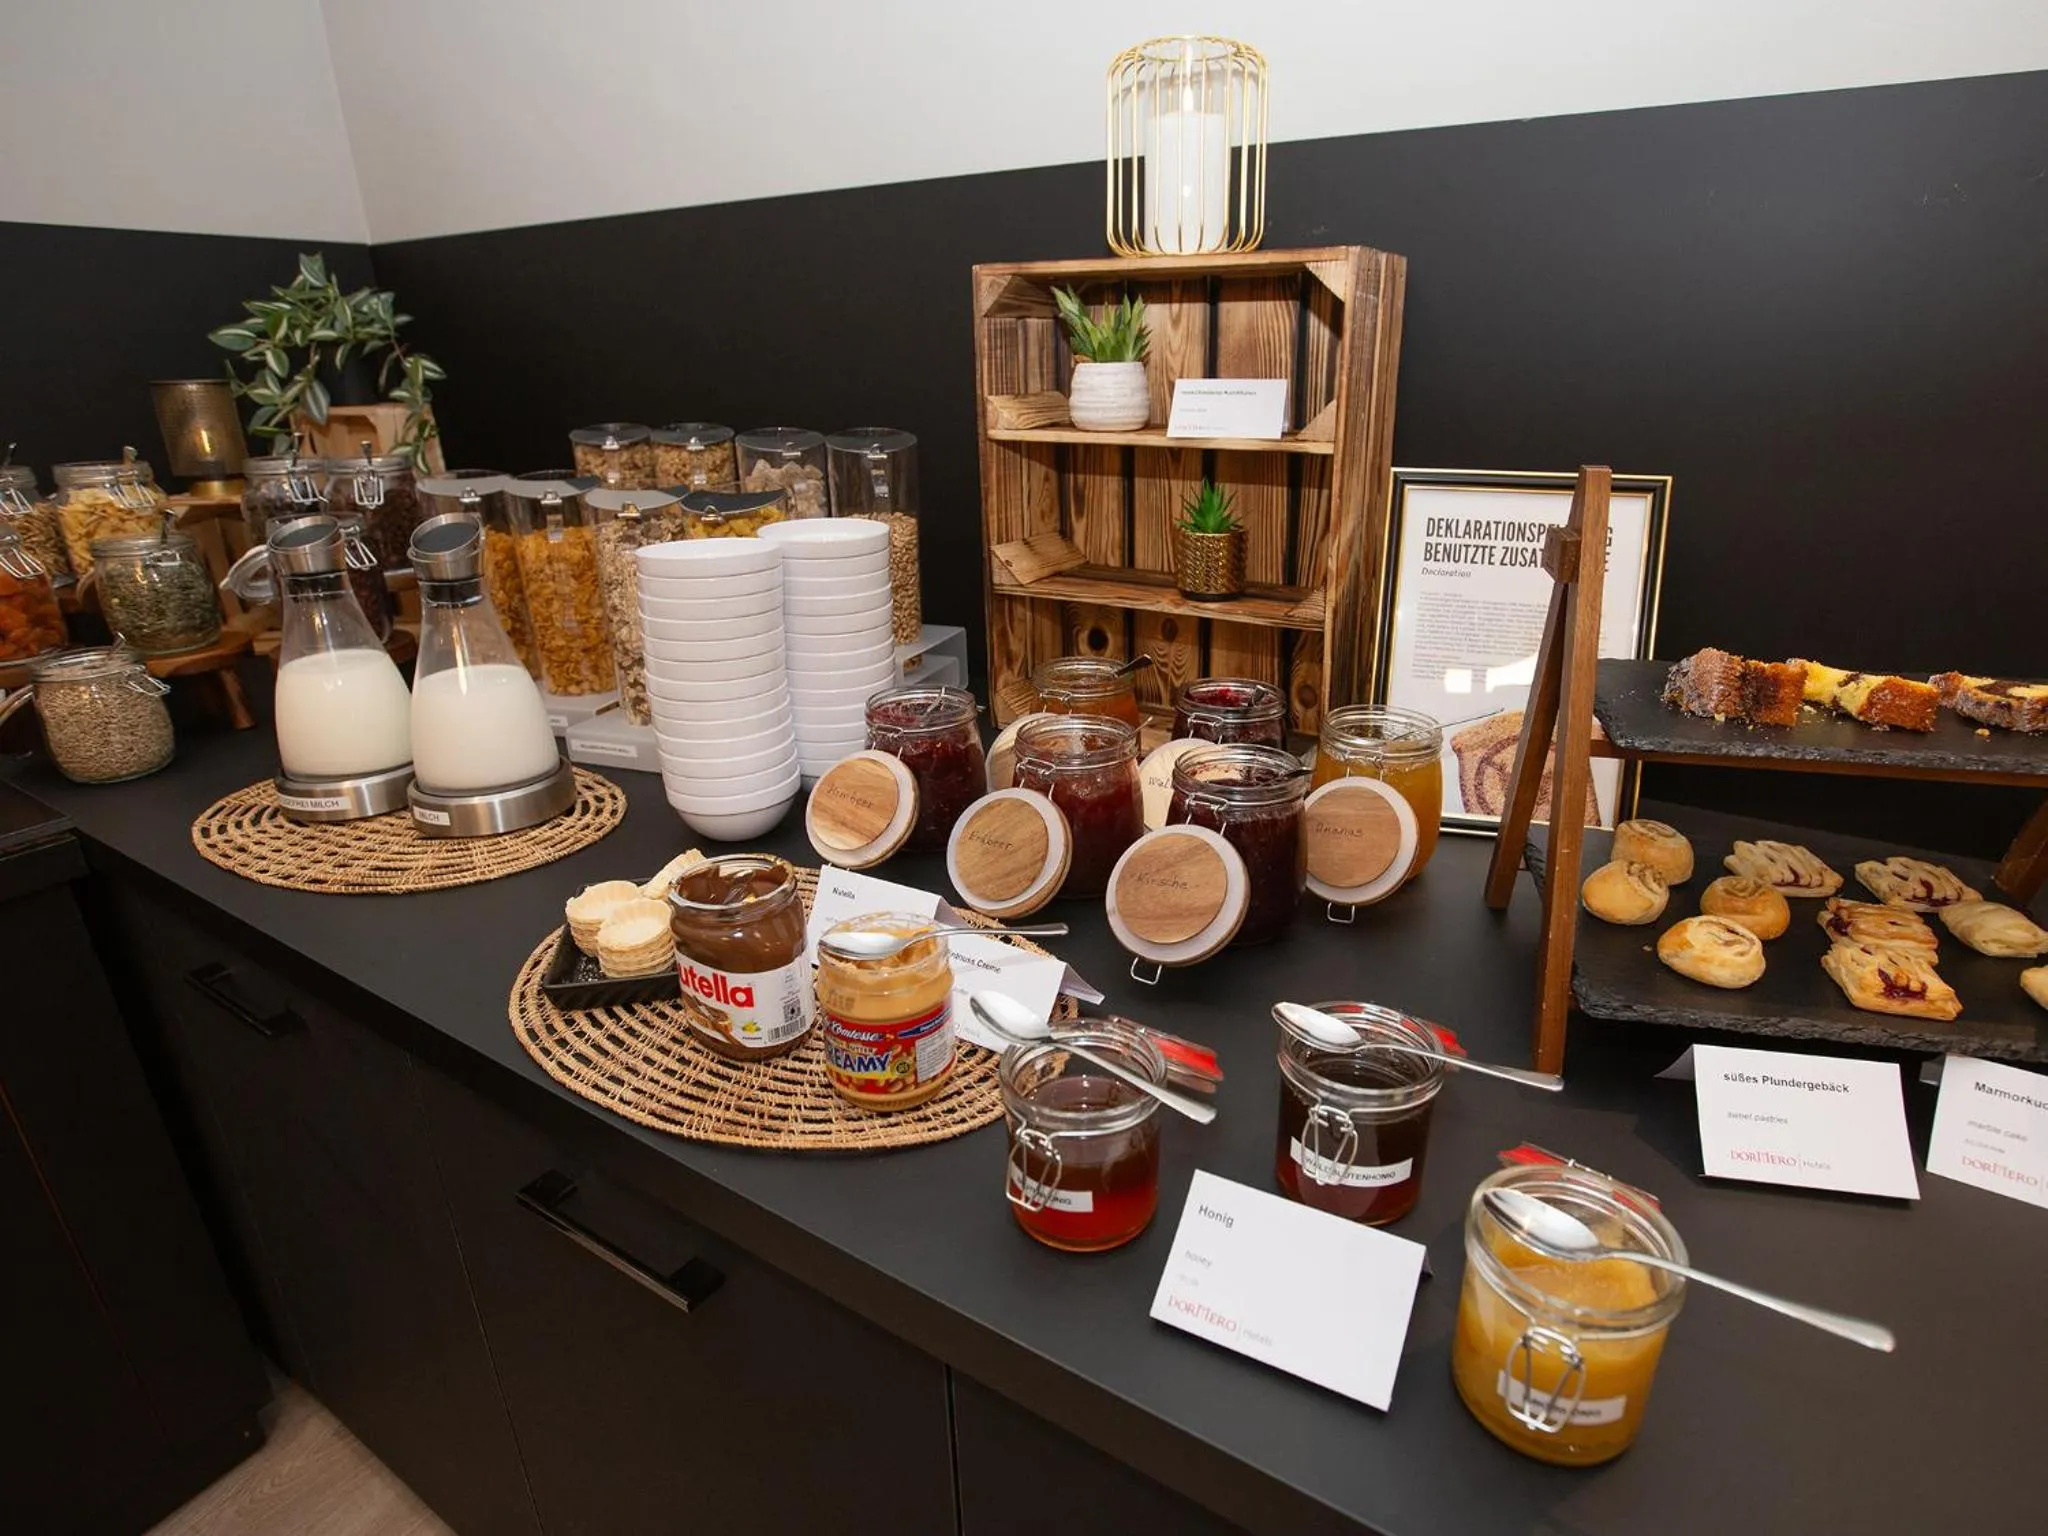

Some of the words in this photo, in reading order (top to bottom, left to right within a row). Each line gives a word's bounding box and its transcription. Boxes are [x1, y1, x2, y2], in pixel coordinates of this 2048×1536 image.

[1424, 542, 1496, 566] BENUTZTE
[832, 886, 856, 899] Nutella
[1136, 873, 1189, 891] Kirsche
[1723, 1069, 1759, 1084] süßes
[1762, 1074, 1850, 1094] Plundergebäck
[1198, 1204, 1235, 1229] Honig
